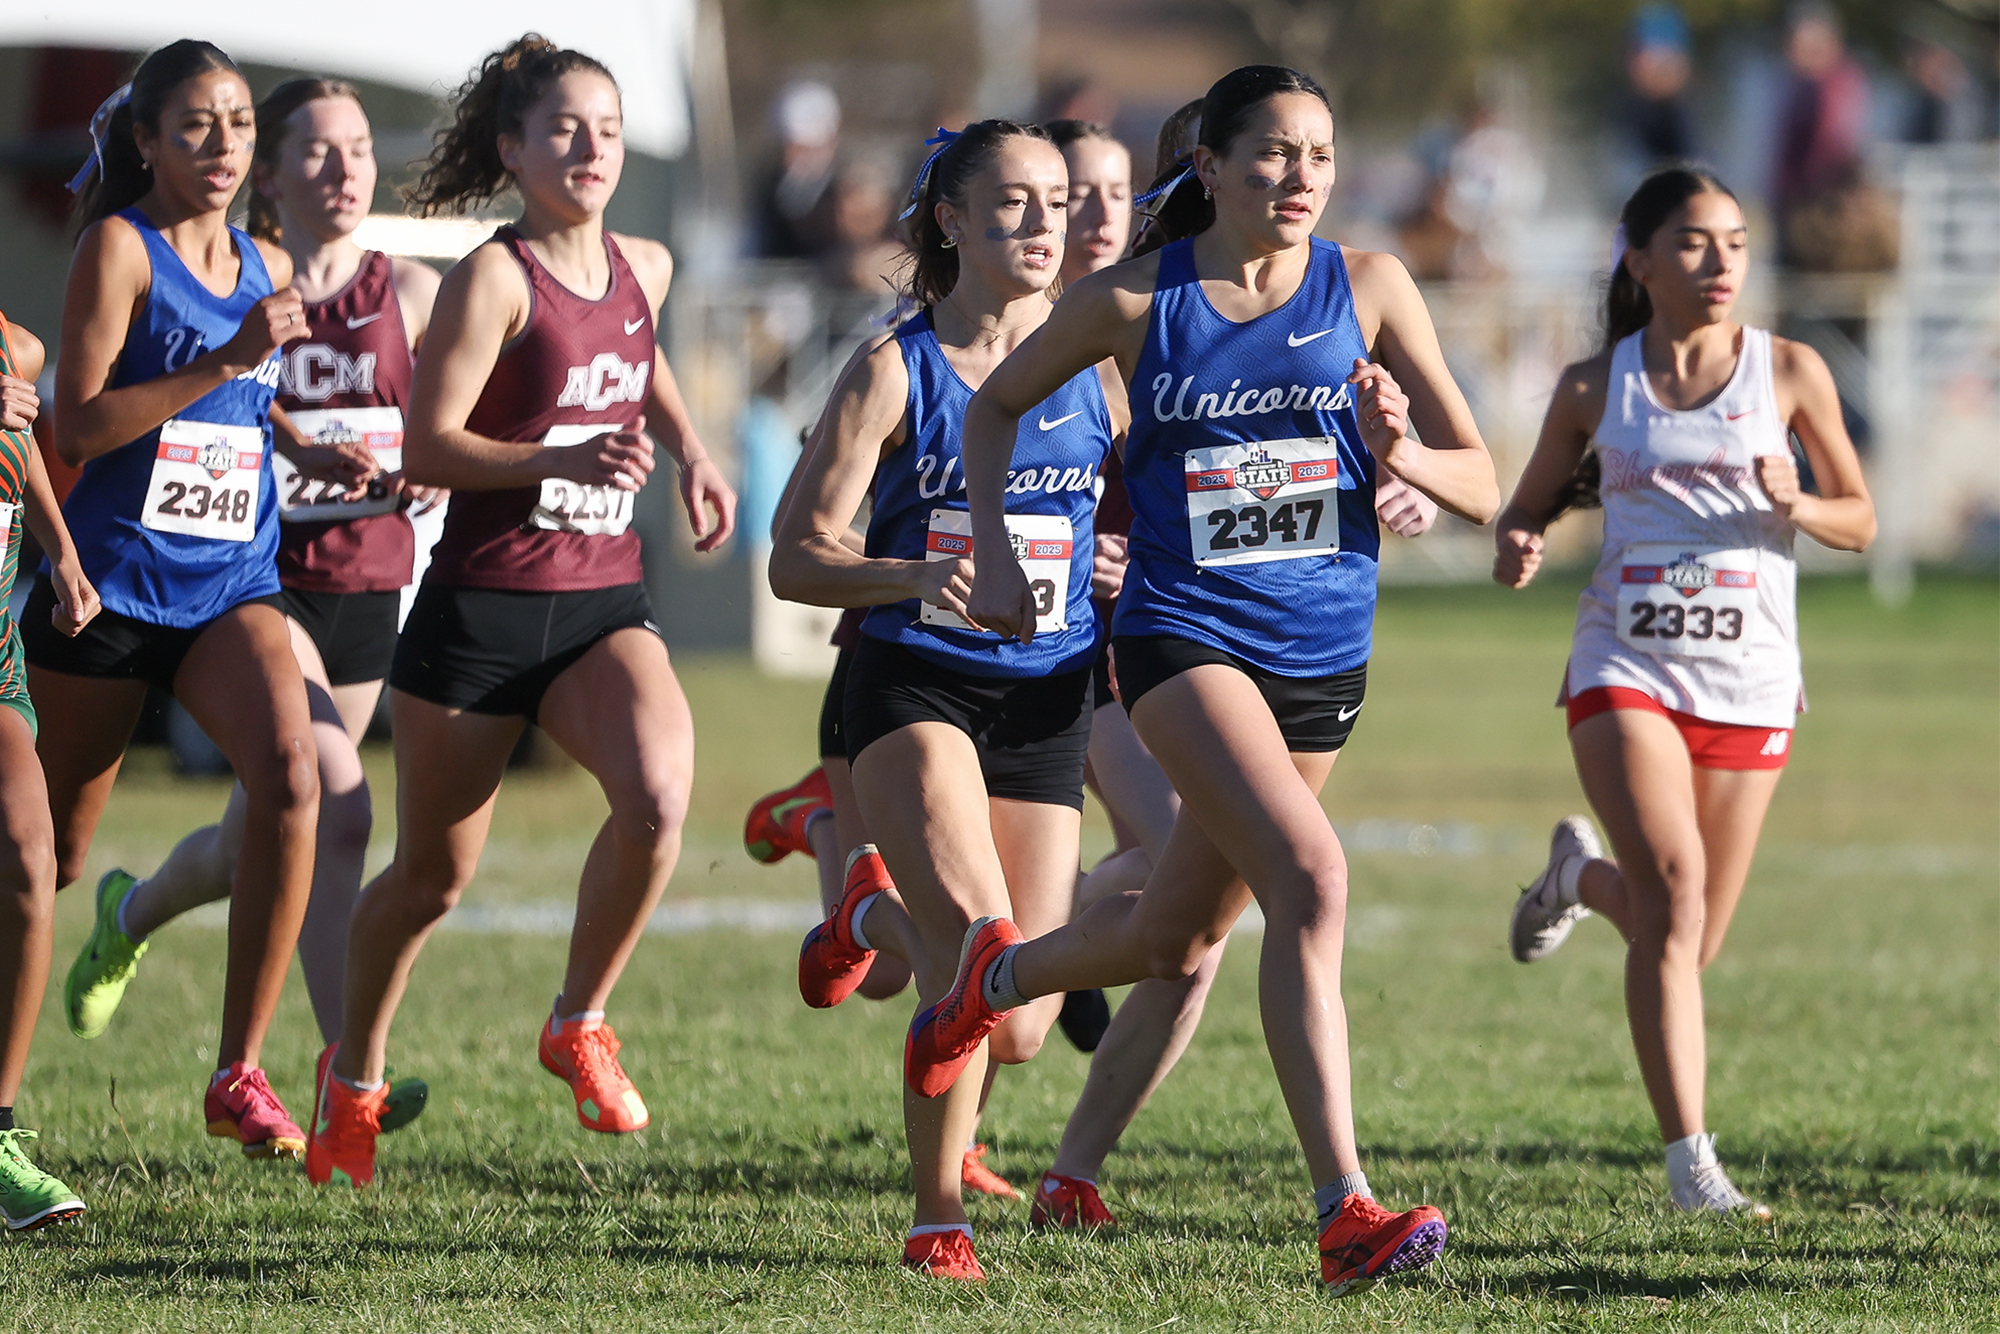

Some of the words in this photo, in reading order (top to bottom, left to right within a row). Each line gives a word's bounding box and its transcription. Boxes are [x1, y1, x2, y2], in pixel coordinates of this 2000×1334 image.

[556, 352, 650, 411] ACM
[1151, 372, 1353, 422] Unicorns
[916, 454, 1094, 499] Ucorns
[1198, 474, 1227, 487] 2025
[1235, 467, 1290, 485] STATE
[1298, 465, 1328, 478] 2025
[1606, 445, 1766, 501] Sharylan
[157, 481, 250, 524] 2348
[938, 538, 966, 551] 2025
[1207, 499, 1324, 551] 2347
[1035, 545, 1063, 555] 2025
[1663, 566, 1714, 585] STATE
[1629, 601, 1744, 641] 2333
